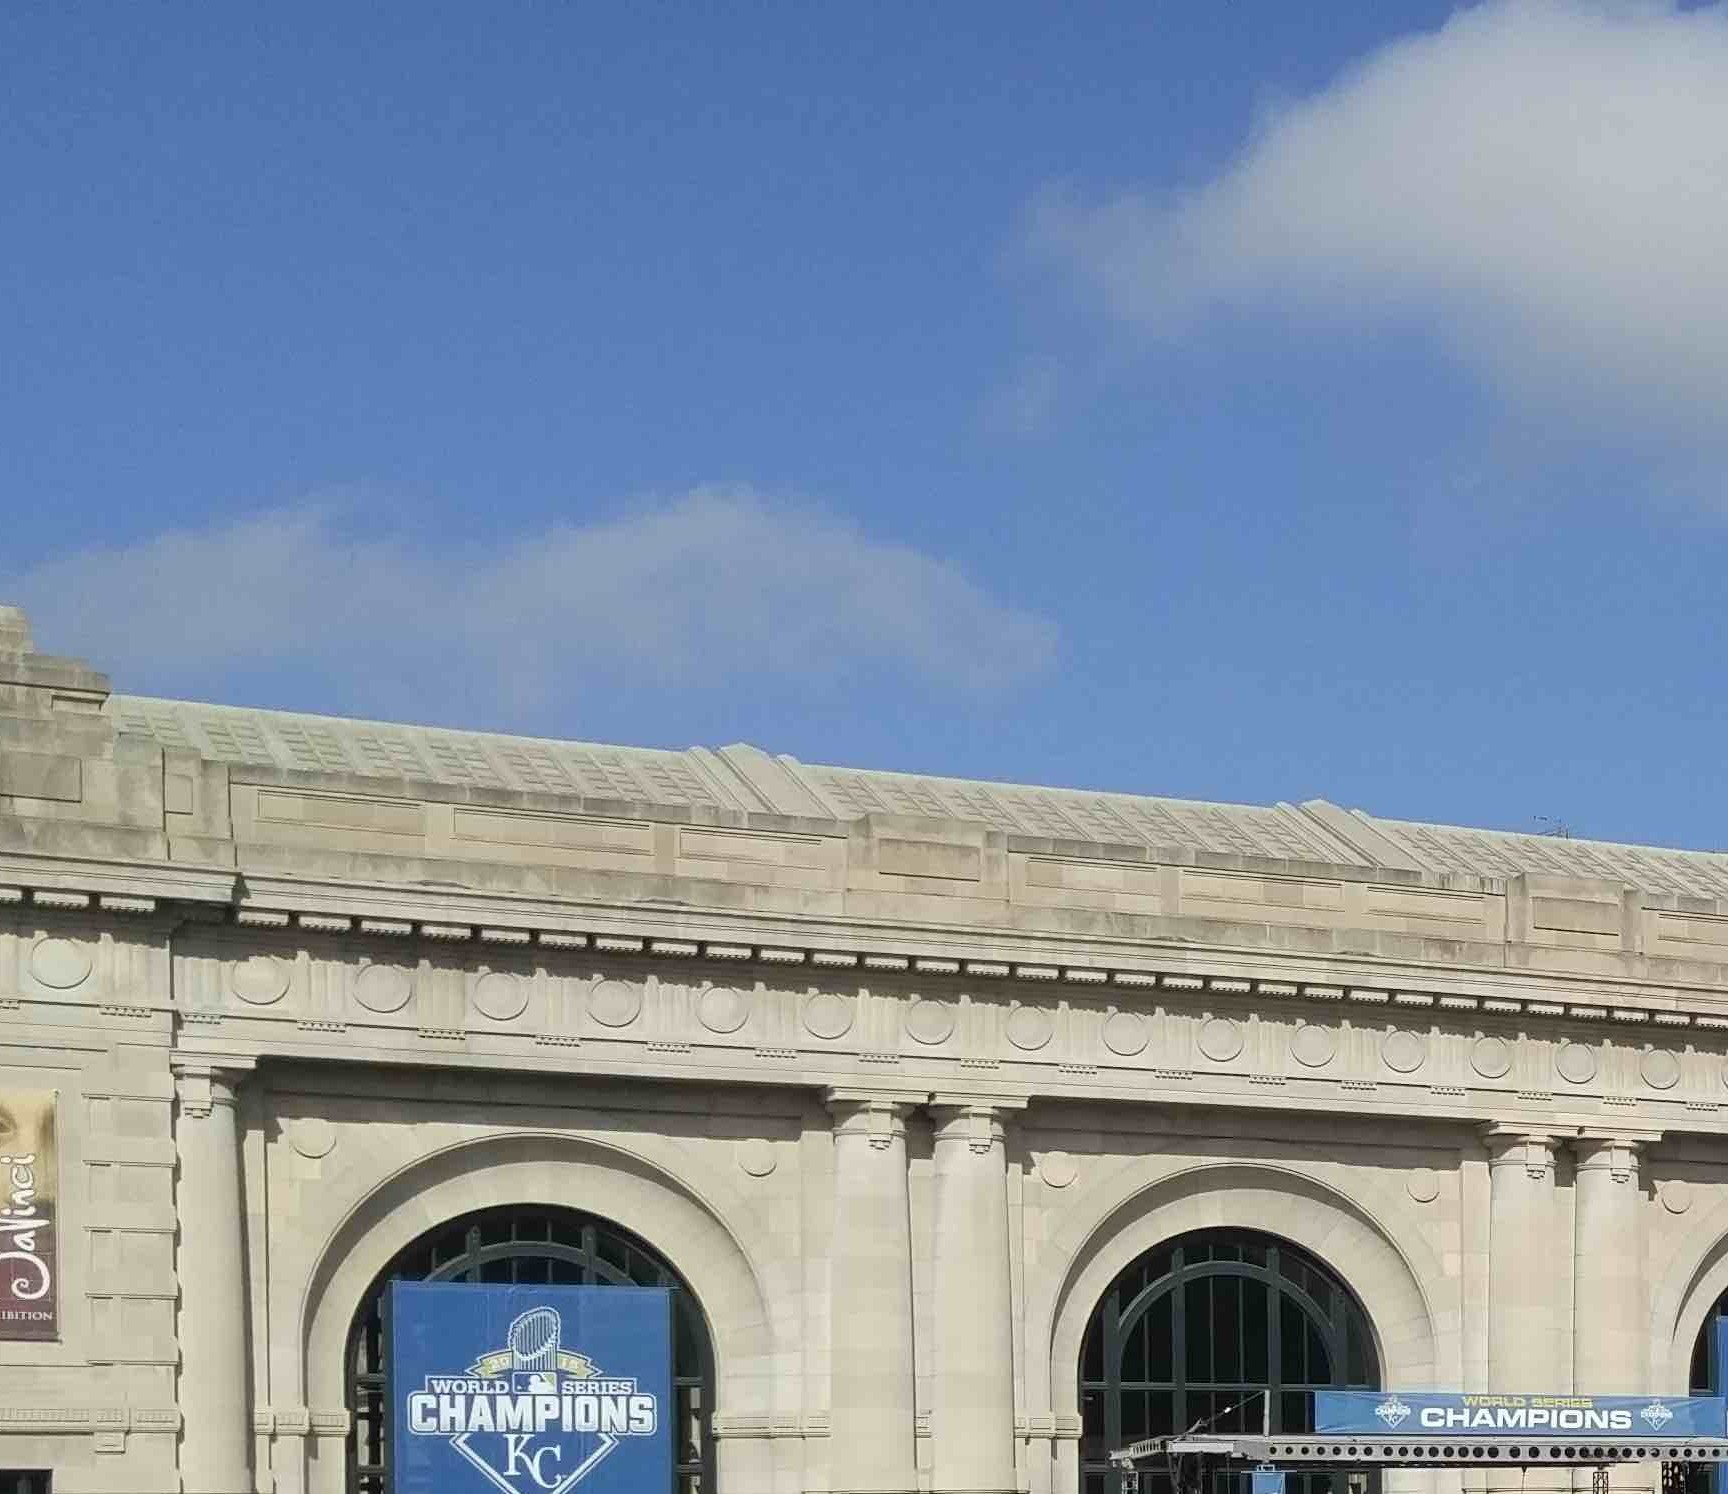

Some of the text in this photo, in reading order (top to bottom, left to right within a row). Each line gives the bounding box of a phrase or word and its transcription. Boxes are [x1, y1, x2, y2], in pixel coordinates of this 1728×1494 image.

[0, 1311, 52, 1322] IBITION
[431, 1379, 633, 1394] WORLD SERIES
[1461, 1395, 1593, 1408] WORLD SERIES
[410, 1392, 656, 1434] CHAMPIONS
[1420, 1407, 1632, 1430] CHAMPIONS
[502, 1433, 561, 1488] KC
